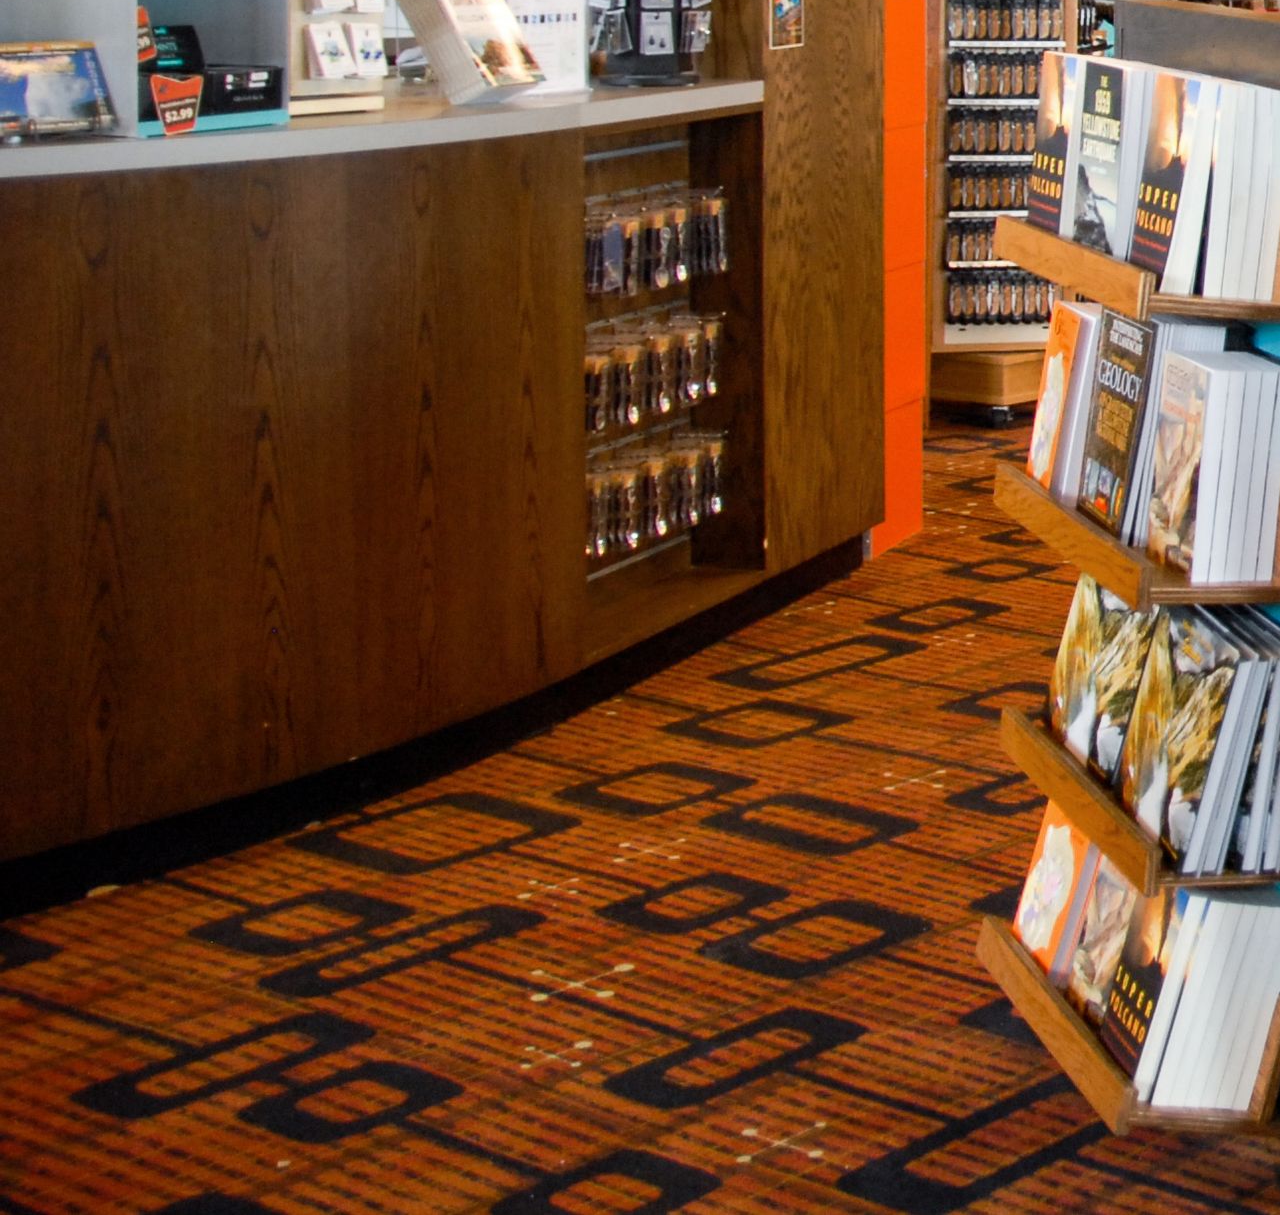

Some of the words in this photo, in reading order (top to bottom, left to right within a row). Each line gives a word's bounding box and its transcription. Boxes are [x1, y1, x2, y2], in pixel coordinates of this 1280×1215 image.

[164, 107, 194, 123] $2.99
[1139, 183, 1178, 212] SUPER
[1136, 208, 1173, 236] VOLCANO
[1099, 359, 1142, 402] GEOLOGY
[1116, 965, 1153, 1019] SUPER
